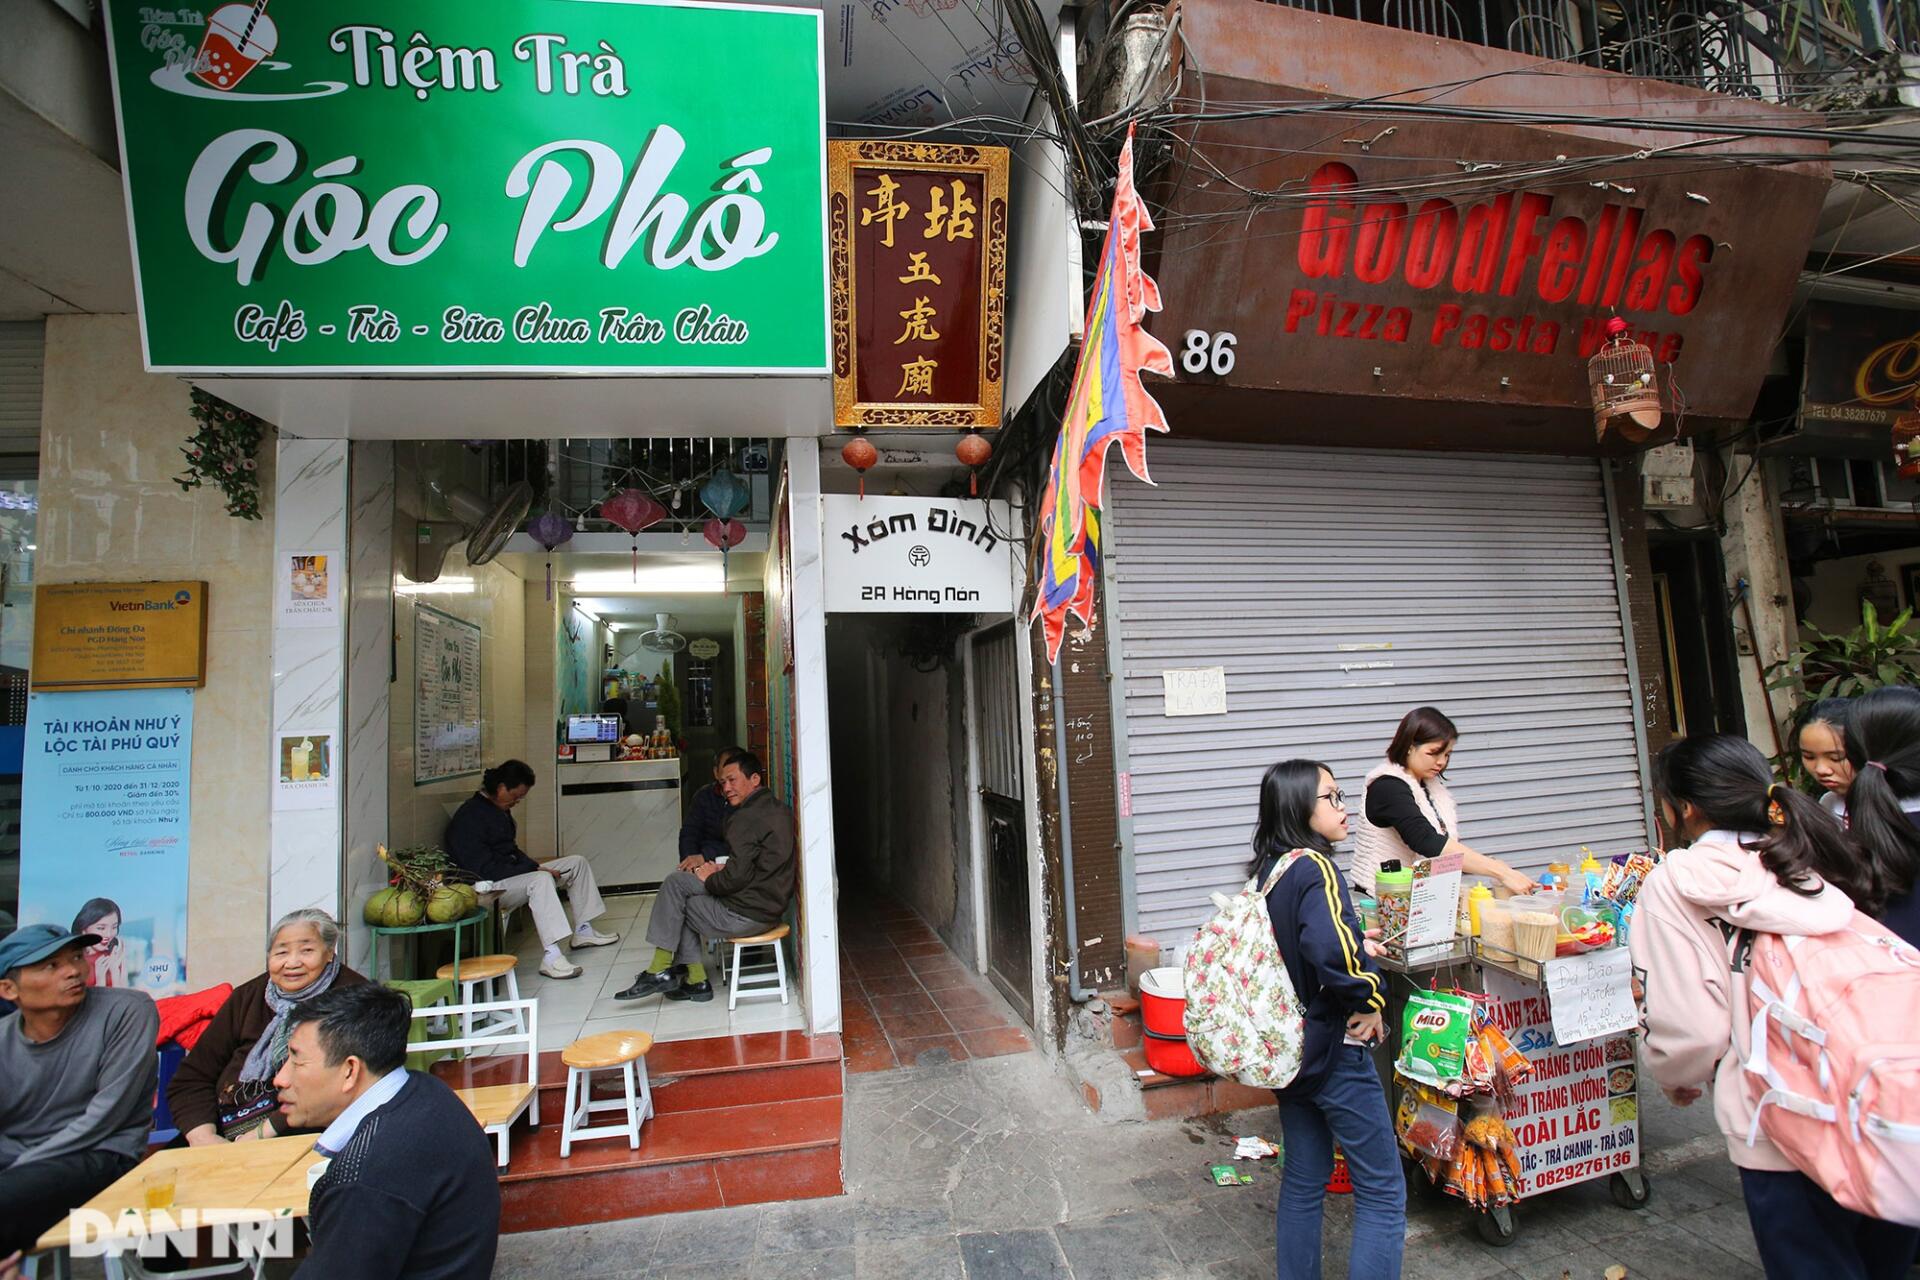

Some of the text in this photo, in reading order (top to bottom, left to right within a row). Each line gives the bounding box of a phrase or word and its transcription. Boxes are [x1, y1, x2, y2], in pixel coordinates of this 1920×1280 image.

[329, 25, 630, 101] Tiệm Trà
[184, 124, 779, 286] Góc Phố
[1297, 161, 1715, 318] GoodFellas
[235, 300, 306, 352] Café
[348, 305, 399, 342] Trà
[442, 306, 503, 342] Sữa
[513, 302, 590, 343] Chua
[598, 306, 665, 344] Trân
[674, 303, 749, 344] Châu
[1283, 288, 1414, 344] Pizza
[1430, 303, 1561, 356] Pasta
[1182, 330, 1238, 376] 86
[841, 507, 997, 554] Xóm Đình
[110, 600, 175, 612] VietinBank
[861, 586, 980, 604] 2A Hàng Nón
[44, 714, 181, 734] TÀI KHOẢN NHƯ Ý
[44, 733, 180, 756] LỘC TÀI PHÚ QUÝ
[1556, 964, 1578, 990] Đá
[1581, 984, 1616, 1001] Matcha
[1416, 1013, 1445, 1027] MILO
[1532, 1052, 1571, 1083] TRÁNG
[1573, 1039, 1604, 1073] CUỐN
[1531, 1085, 1569, 1114] TRÁNG
[1569, 1074, 1607, 1107] NƯỚNG
[1511, 1104, 1601, 1148] XOÀI LẮC
[1520, 1149, 1537, 1174] TẮC
[1545, 1144, 1561, 1167] TRÀ
[1563, 1138, 1593, 1161] CHANH
[1600, 1130, 1617, 1152] TRÀ
[1618, 1125, 1635, 1148] SỮA
[1536, 1150, 1631, 1189] 0829276136
